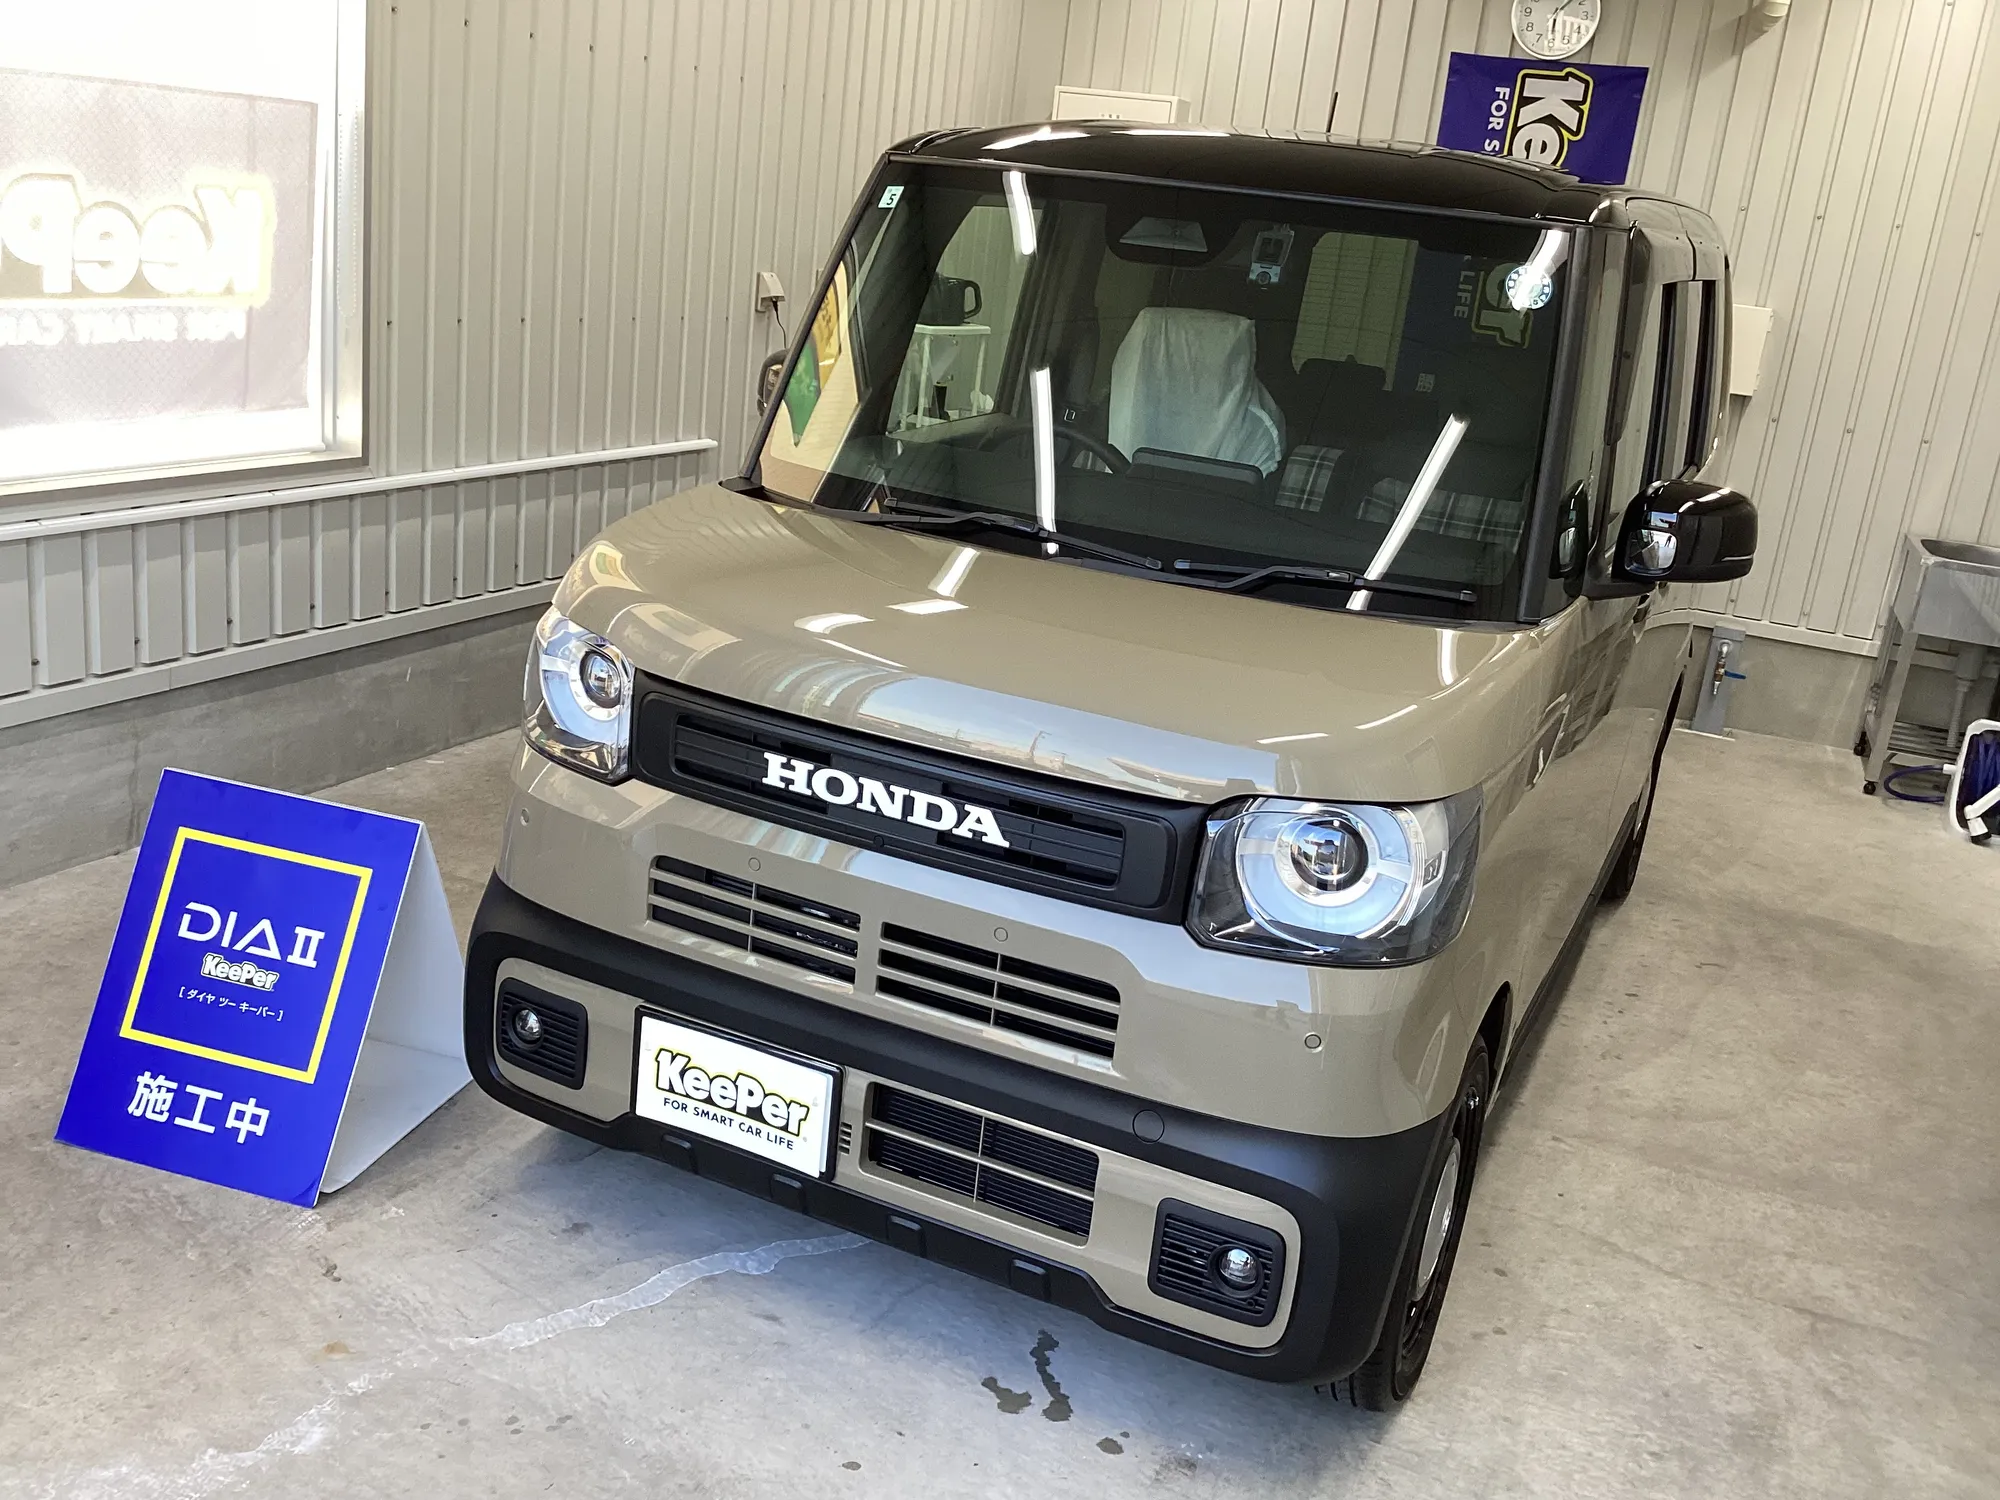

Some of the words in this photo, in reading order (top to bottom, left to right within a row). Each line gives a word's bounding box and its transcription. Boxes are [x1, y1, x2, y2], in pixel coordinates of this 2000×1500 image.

[1524, 6, 1533, 17] 9
[1525, 21, 1534, 32] 8
[1580, 10, 1589, 21] 3
[1535, 33, 1544, 43] 7
[1561, 35, 1571, 46] 5
[1487, 86, 1511, 131] FOR
[886, 193, 897, 206] 5
[1453, 270, 1476, 319] LIFE
[761, 751, 1011, 849] HONDA
[177, 901, 282, 961] DIA
[202, 953, 279, 991] KeePer
[127, 1070, 271, 1145] 施工中
[655, 1047, 810, 1137] KeePer
[663, 1096, 688, 1114] FOR
[693, 1106, 735, 1128] SMART
[738, 1121, 762, 1139] CAR
[766, 1130, 794, 1151] LIFE
